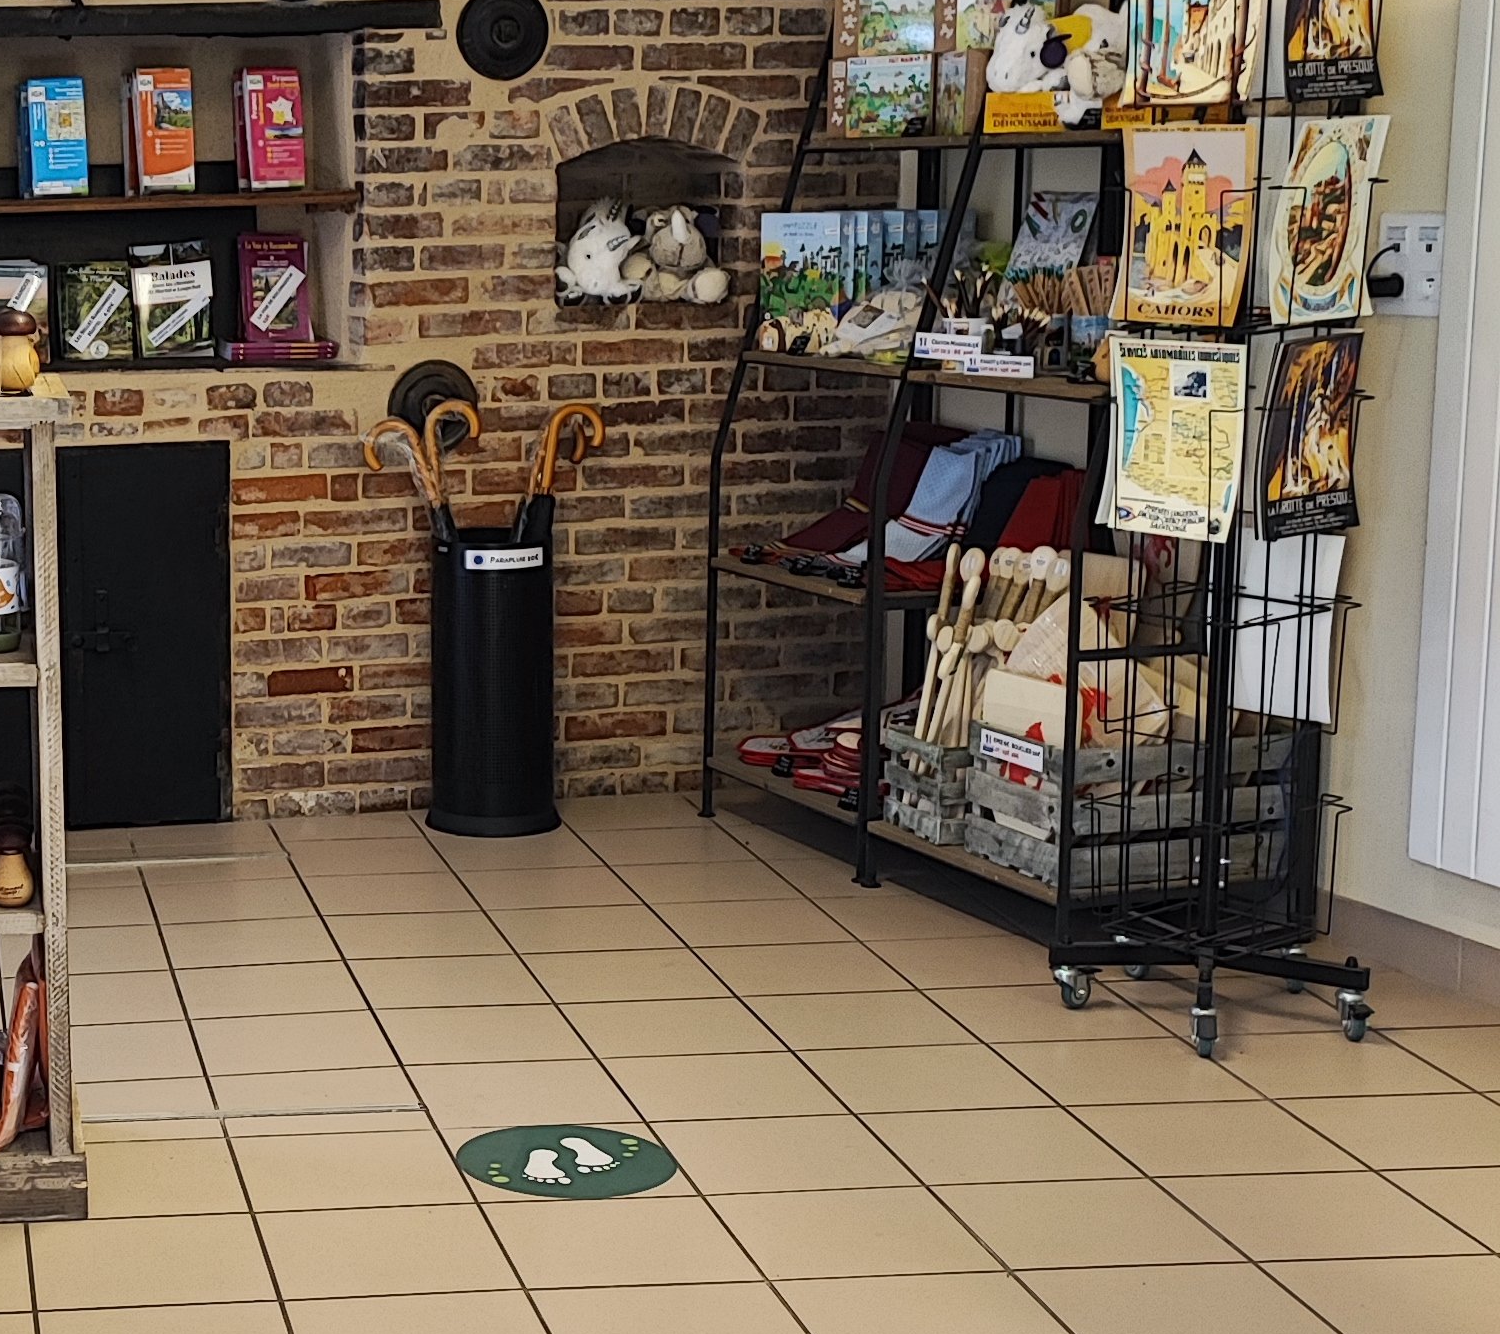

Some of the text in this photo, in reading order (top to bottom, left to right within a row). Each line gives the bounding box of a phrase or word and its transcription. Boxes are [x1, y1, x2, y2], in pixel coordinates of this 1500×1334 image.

[1288, 68, 1297, 78] LA
[1297, 61, 1325, 78] GROTTE
[1337, 58, 1375, 75] PRESQUE
[993, 117, 1058, 129] DÉHOUSSABLE
[150, 269, 196, 282] Balades
[1137, 303, 1216, 318] CAHORS
[1150, 347, 1197, 361] AUTOMOBILES
